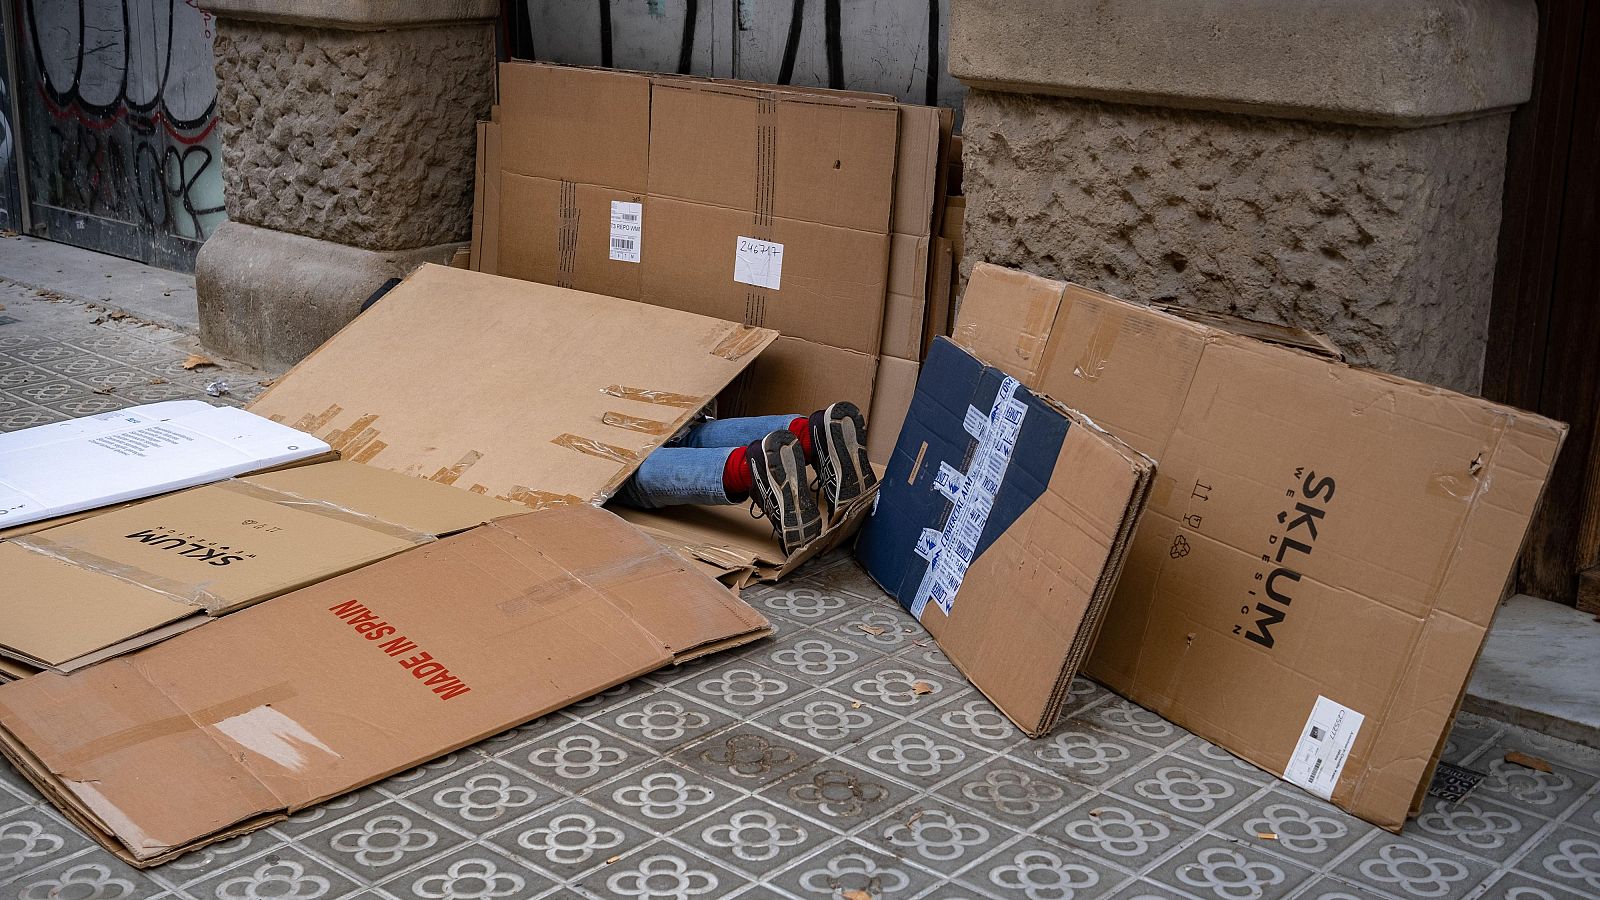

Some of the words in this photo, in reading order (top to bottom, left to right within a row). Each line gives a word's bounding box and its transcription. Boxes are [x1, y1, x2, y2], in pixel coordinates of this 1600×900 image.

[1286, 467, 1305, 498] WE
[124, 529, 244, 566] SKLUM
[1244, 470, 1336, 650] SKLUM
[1232, 534, 1279, 636] DESIGN
[328, 599, 397, 640] SPAIN
[377, 635, 418, 657] IN
[398, 651, 471, 701] MADE
